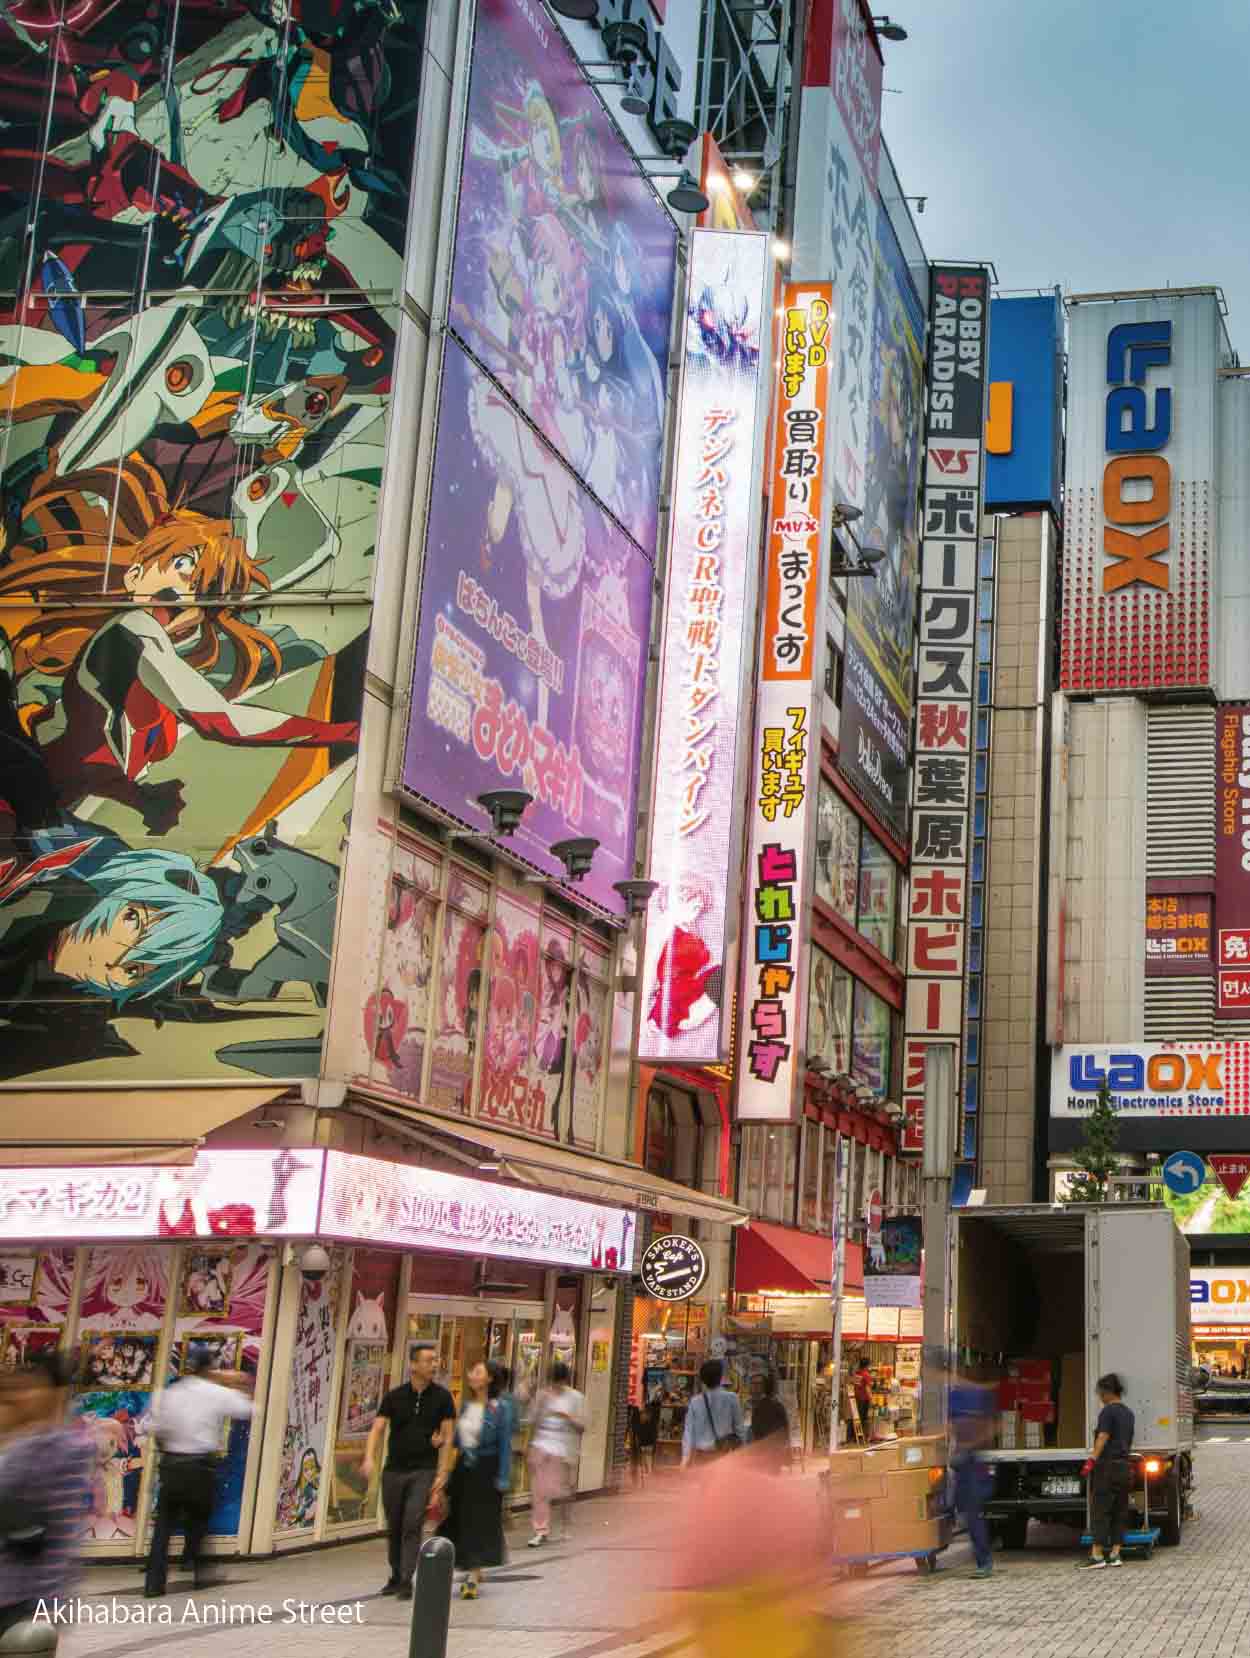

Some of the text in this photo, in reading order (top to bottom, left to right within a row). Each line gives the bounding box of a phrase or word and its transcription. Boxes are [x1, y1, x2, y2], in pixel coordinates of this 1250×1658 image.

[808, 299, 829, 368] DVD
[929, 274, 957, 432] PARADISE
[958, 274, 985, 380] HOBBY
[783, 409, 820, 504] 買取り
[776, 549, 811, 666] まっくす
[759, 727, 783, 822] 買います
[783, 706, 807, 818] フィギュア
[1221, 714, 1239, 835] Flagship Store
[751, 843, 797, 1083] とれじゃらす
[1067, 1095, 1102, 1109] Hom
[1187, 1093, 1225, 1107] Store
[1216, 1164, 1249, 1175] 止まれ
[646, 1274, 697, 1297] VAPE STAND
[647, 1238, 700, 1261] SMOKER'S
